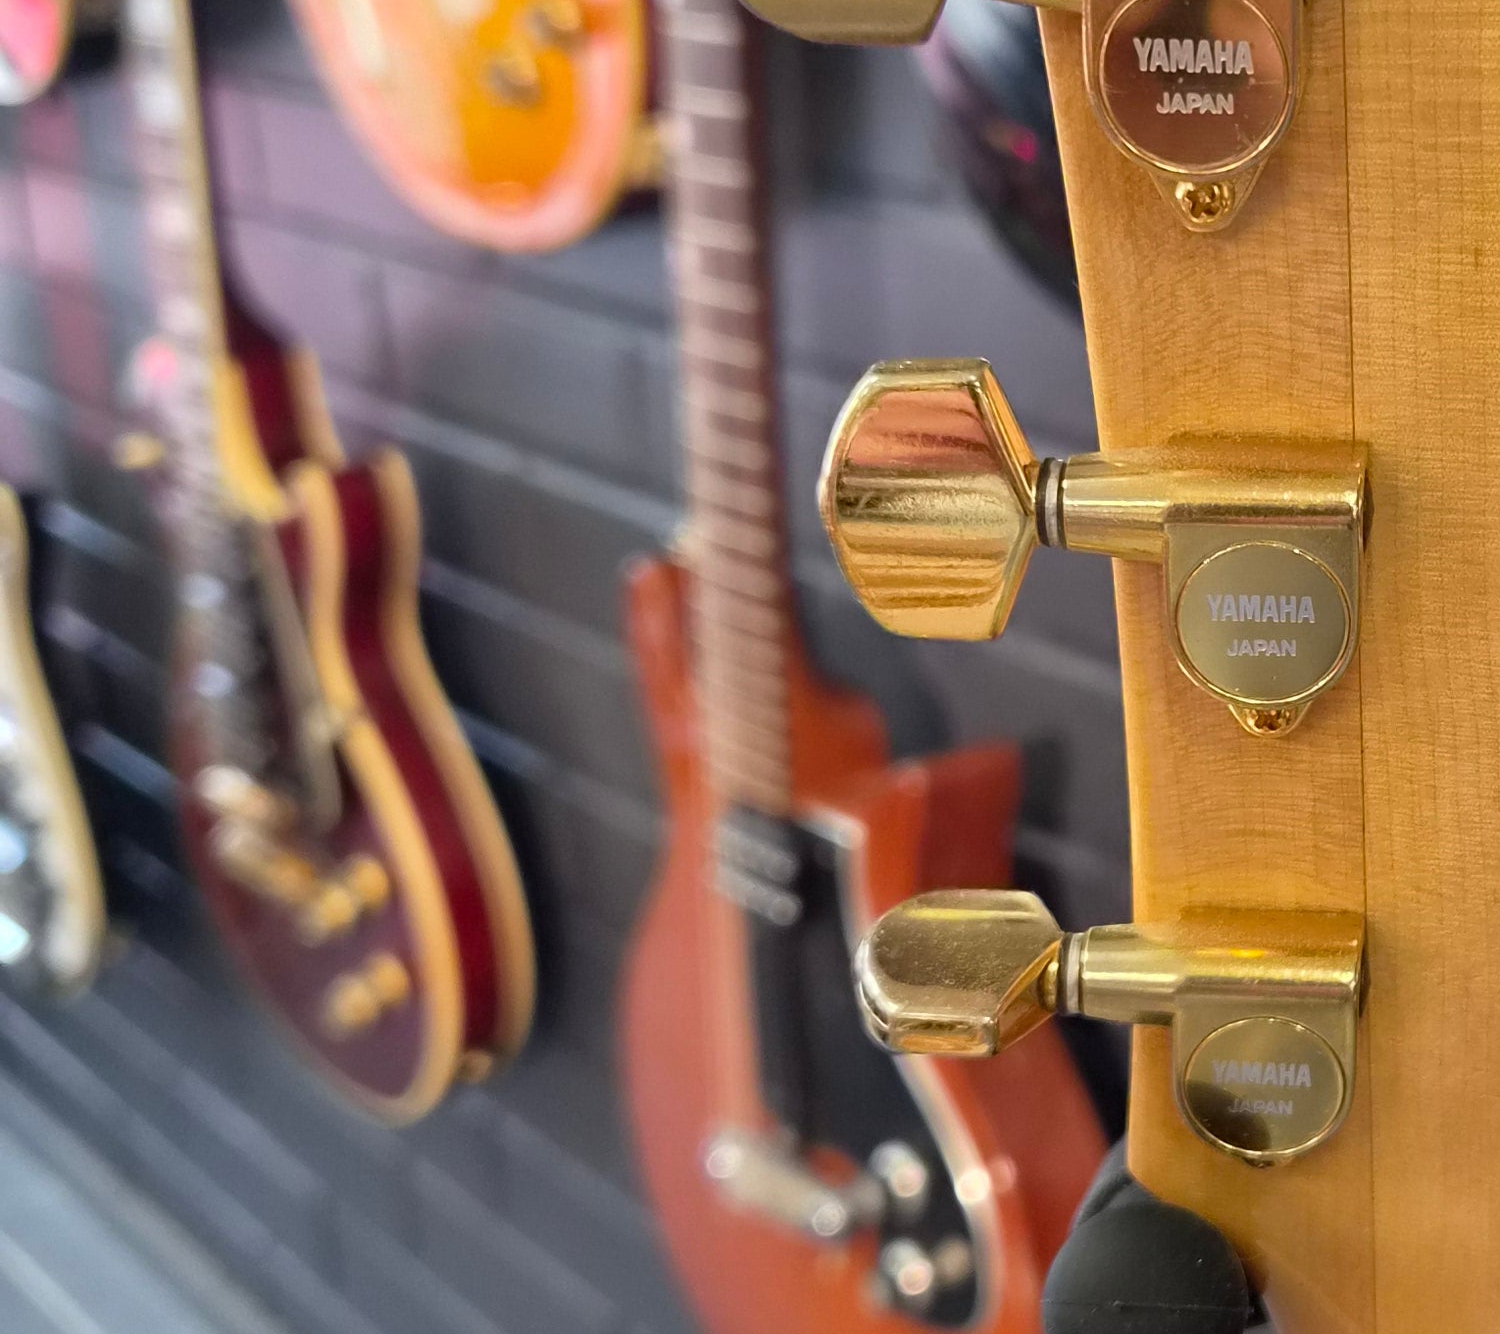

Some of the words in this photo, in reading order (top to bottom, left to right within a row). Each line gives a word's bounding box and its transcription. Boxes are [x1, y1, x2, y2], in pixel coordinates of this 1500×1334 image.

[1134, 37, 1254, 75] YAMAHA
[1156, 92, 1233, 115] JAPAN
[1208, 595, 1315, 623] YAMAHA
[1227, 639, 1296, 657] JAPAN
[1212, 1060, 1311, 1087] YAMAHA
[1228, 1098, 1293, 1115] JAPAN
